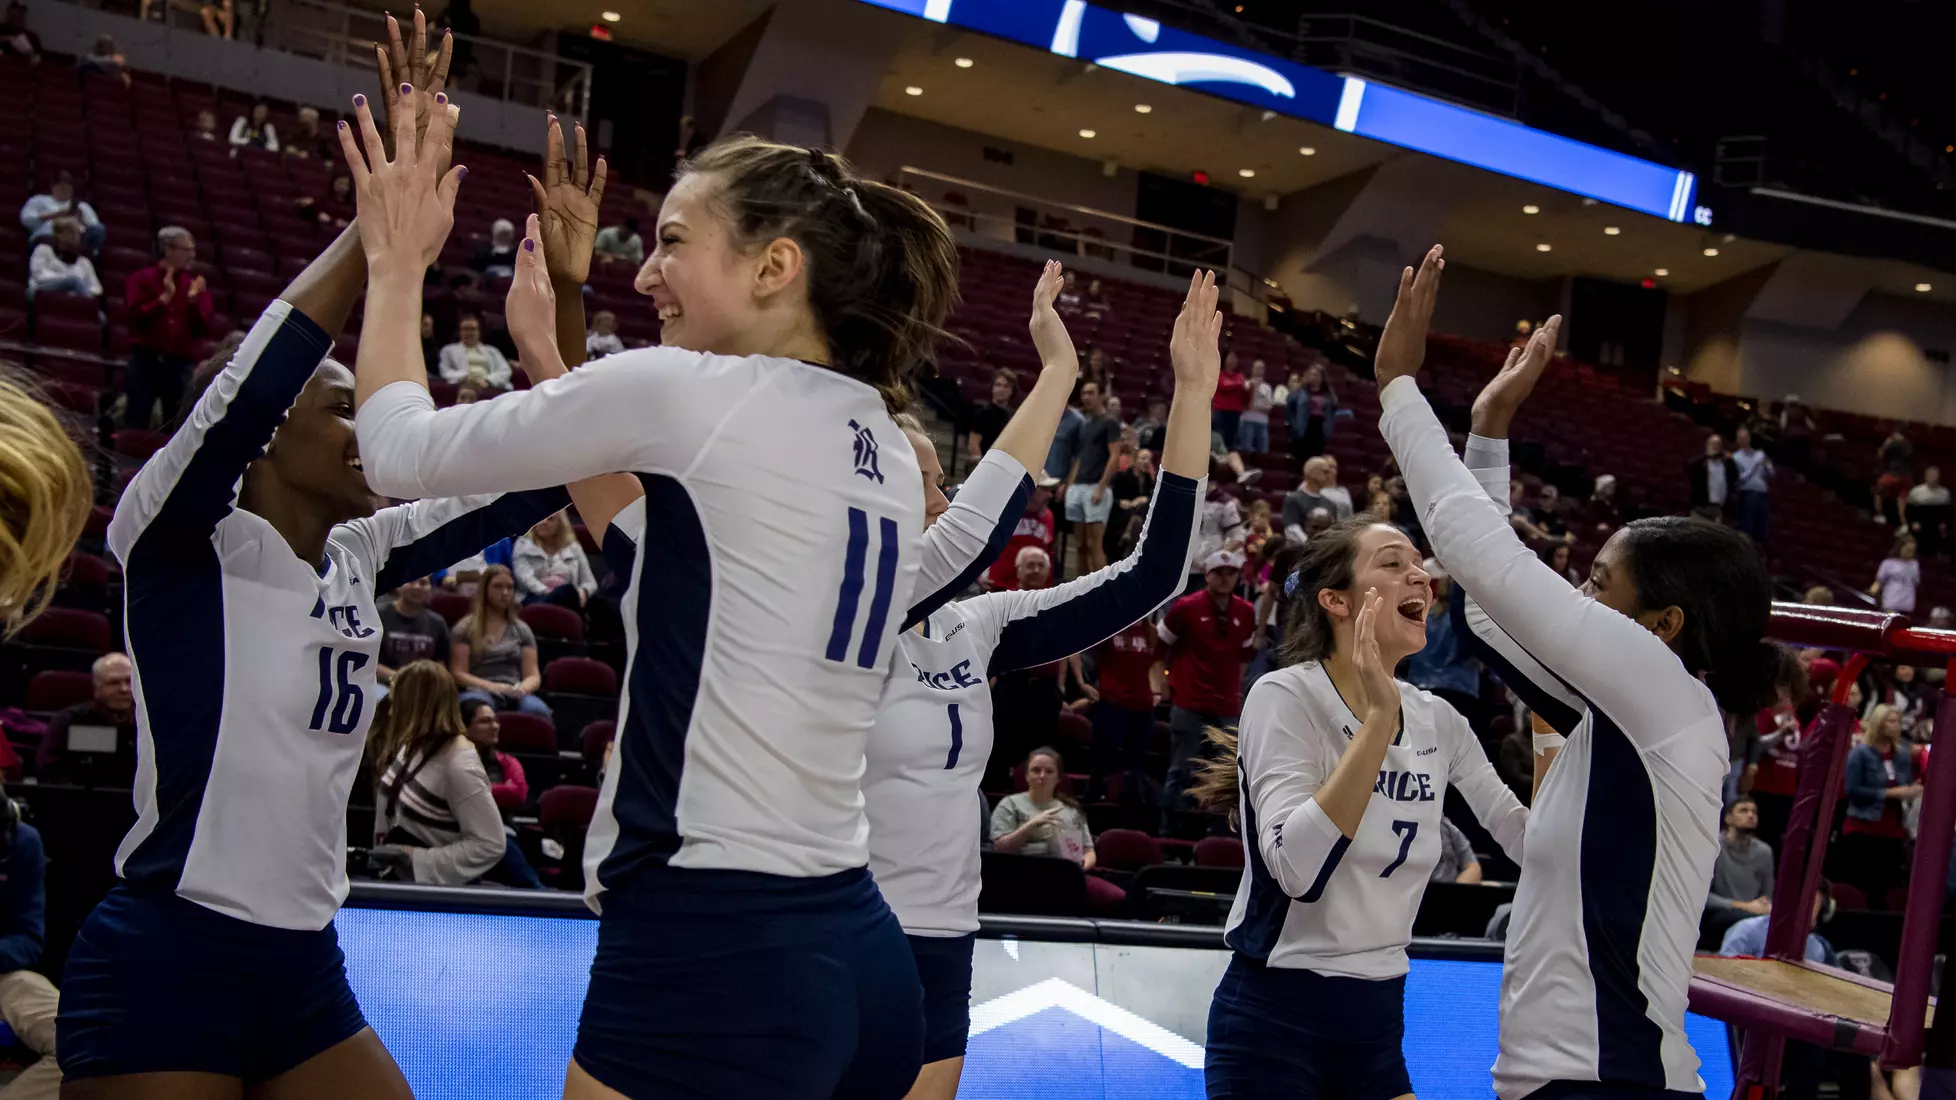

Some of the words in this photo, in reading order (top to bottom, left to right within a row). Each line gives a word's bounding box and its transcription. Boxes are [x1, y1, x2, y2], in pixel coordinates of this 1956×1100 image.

[825, 506, 898, 669] 11
[308, 645, 370, 734] 16
[943, 703, 963, 770] 1
[1379, 819, 1419, 878] 7
